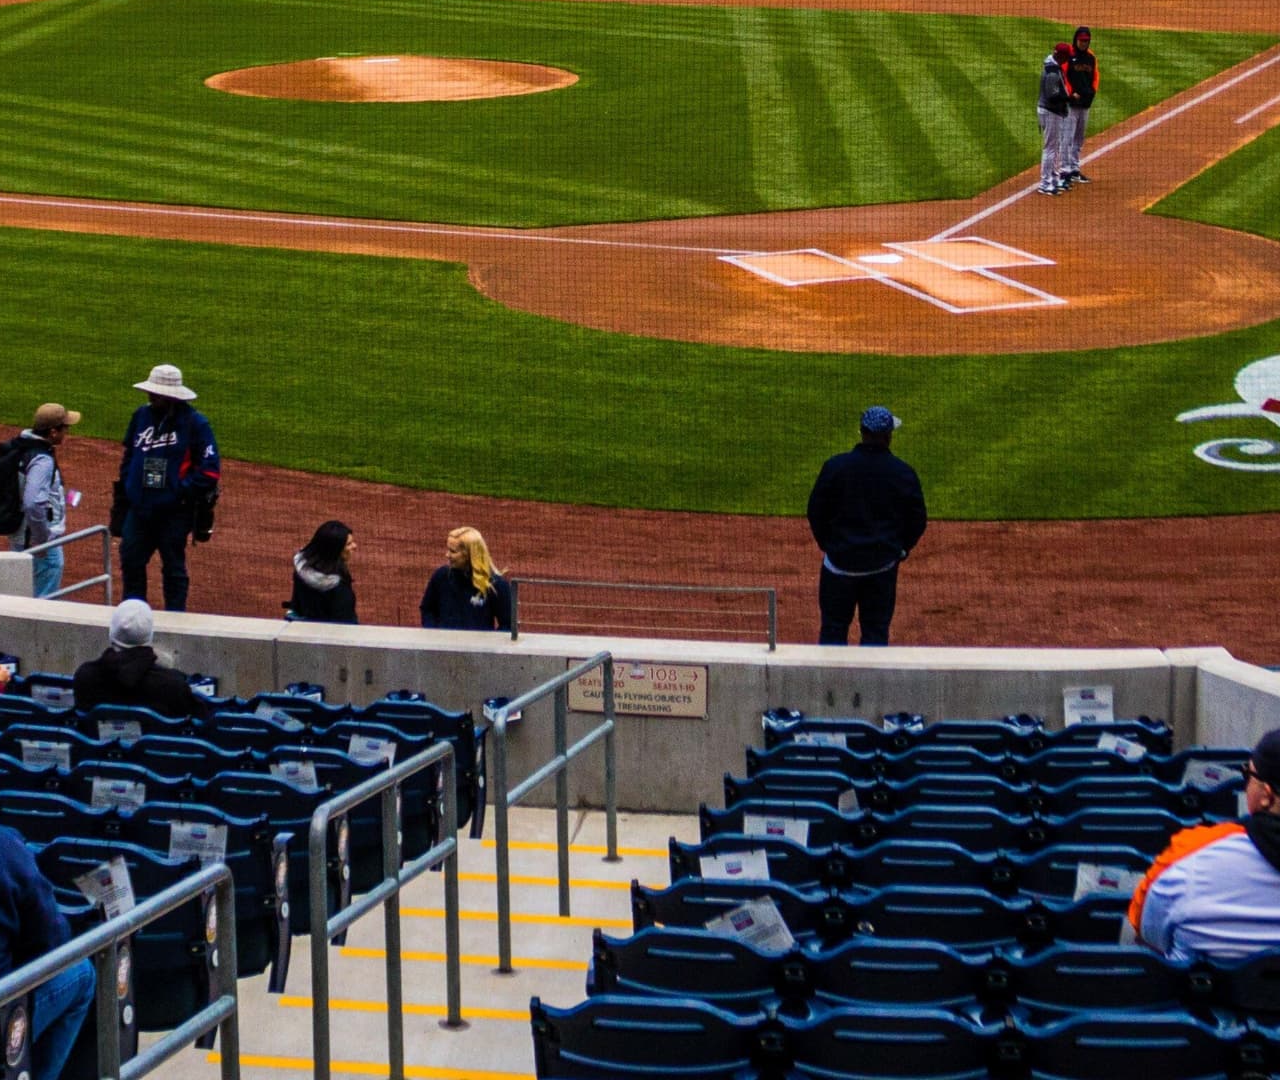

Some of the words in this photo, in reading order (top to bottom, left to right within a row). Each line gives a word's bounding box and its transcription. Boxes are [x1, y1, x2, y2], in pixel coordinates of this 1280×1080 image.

[650, 667, 677, 681] 108
[653, 683, 678, 691] SEATS
[624, 693, 654, 701] FLYING
[656, 695, 692, 704] OBJECTS
[618, 703, 672, 712] TRESPASSING
